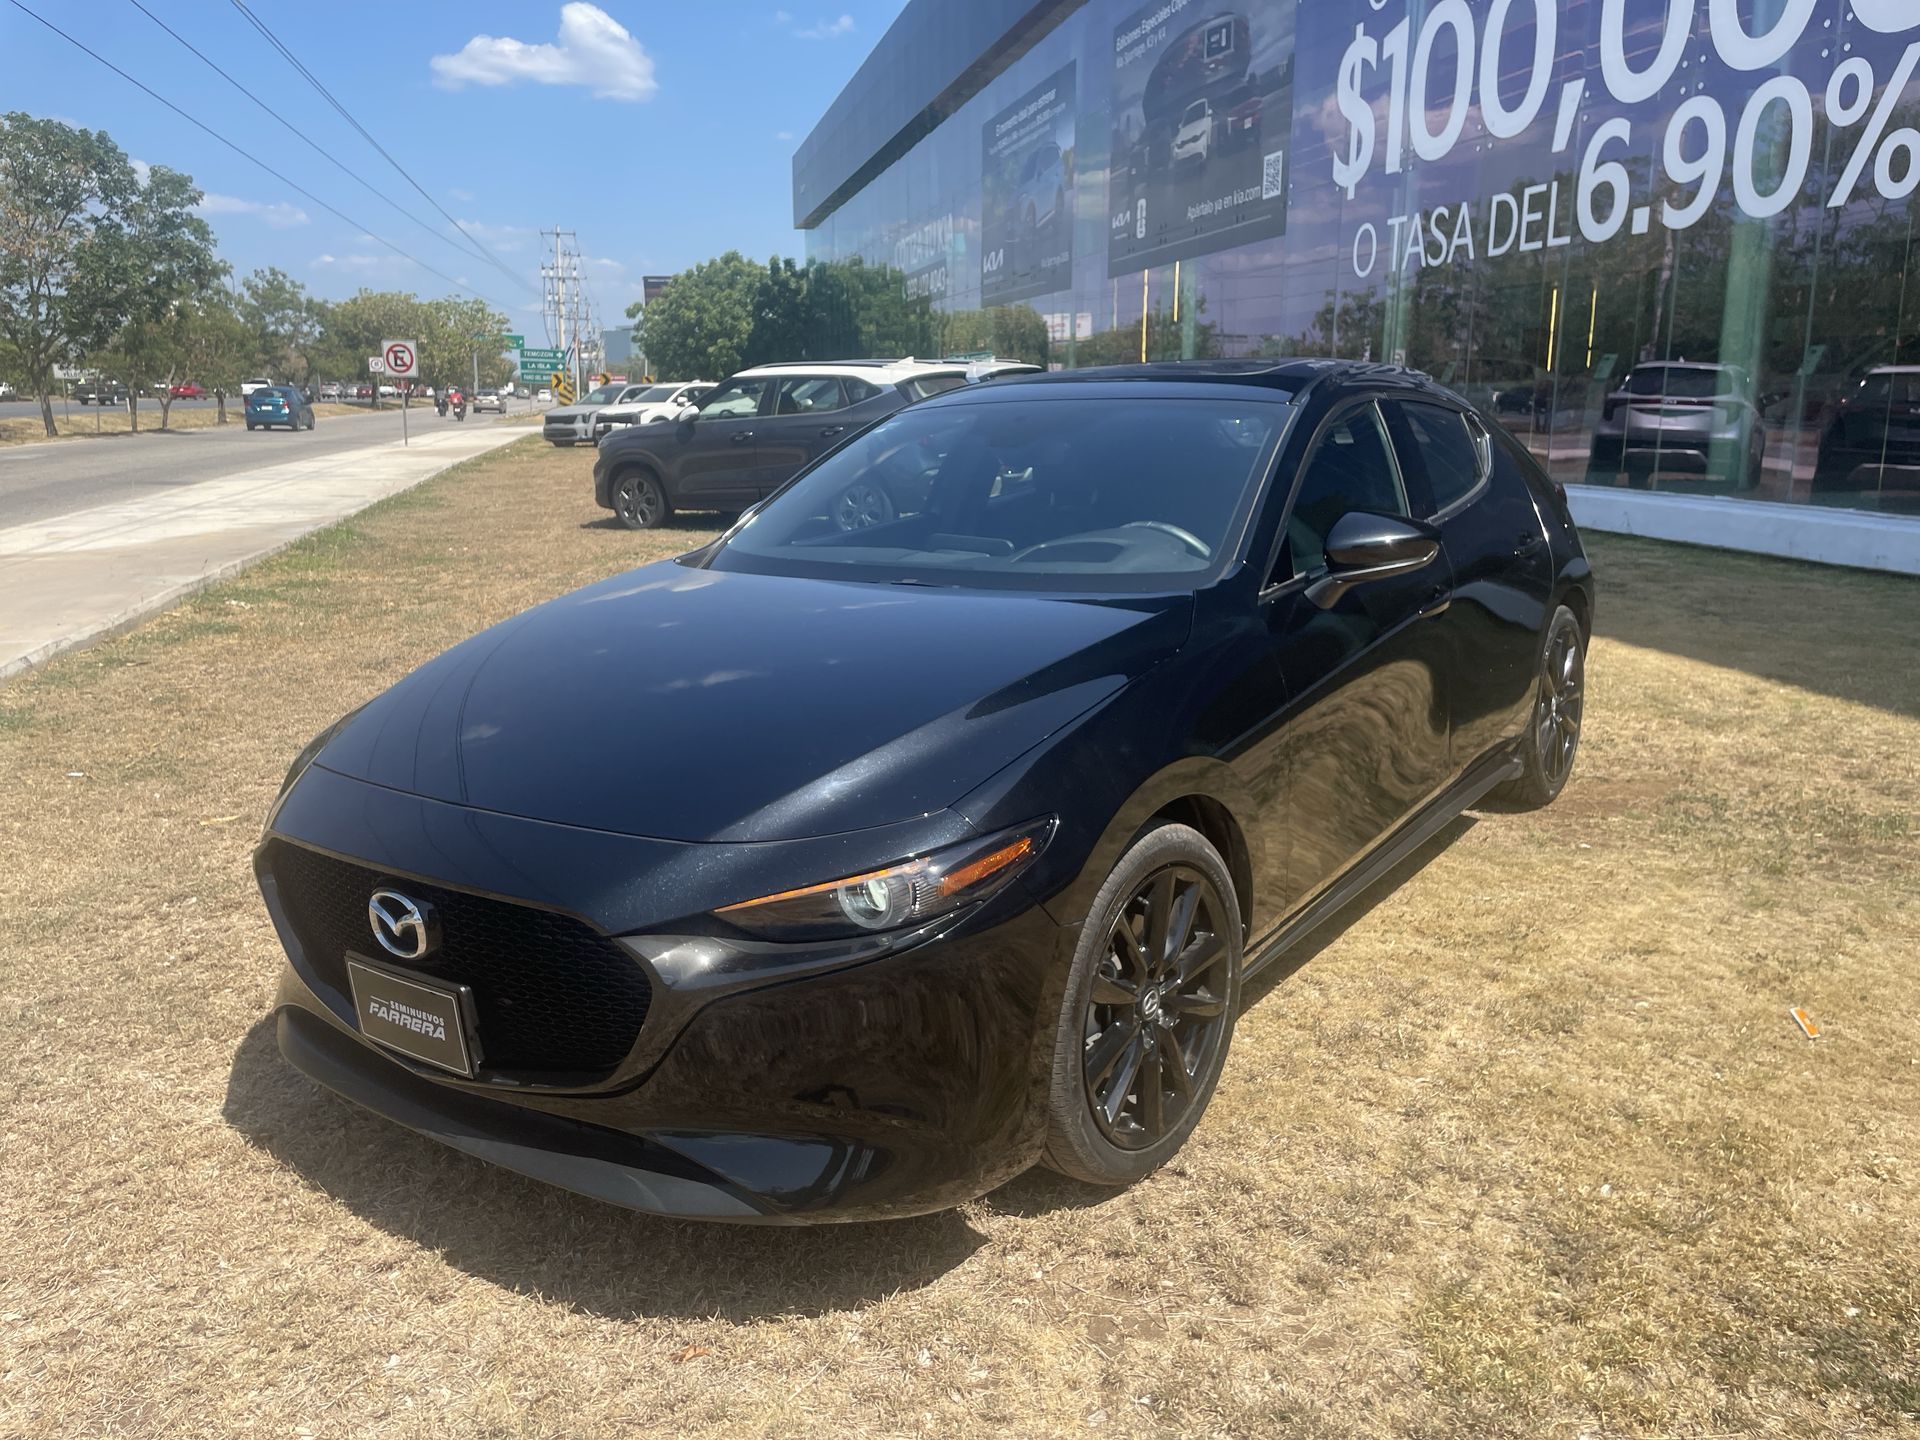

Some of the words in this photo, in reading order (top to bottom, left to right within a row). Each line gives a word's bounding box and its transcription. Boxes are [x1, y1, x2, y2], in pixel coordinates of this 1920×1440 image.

[1353, 222, 1377, 278] O
[1387, 201, 1475, 273] TASA
[1487, 180, 1571, 257] DEL
[1576, 41, 1920, 243] 6.90%
[369, 1002, 446, 1041] FARRERA
[389, 1000, 445, 1026] SEMINUEVOS
